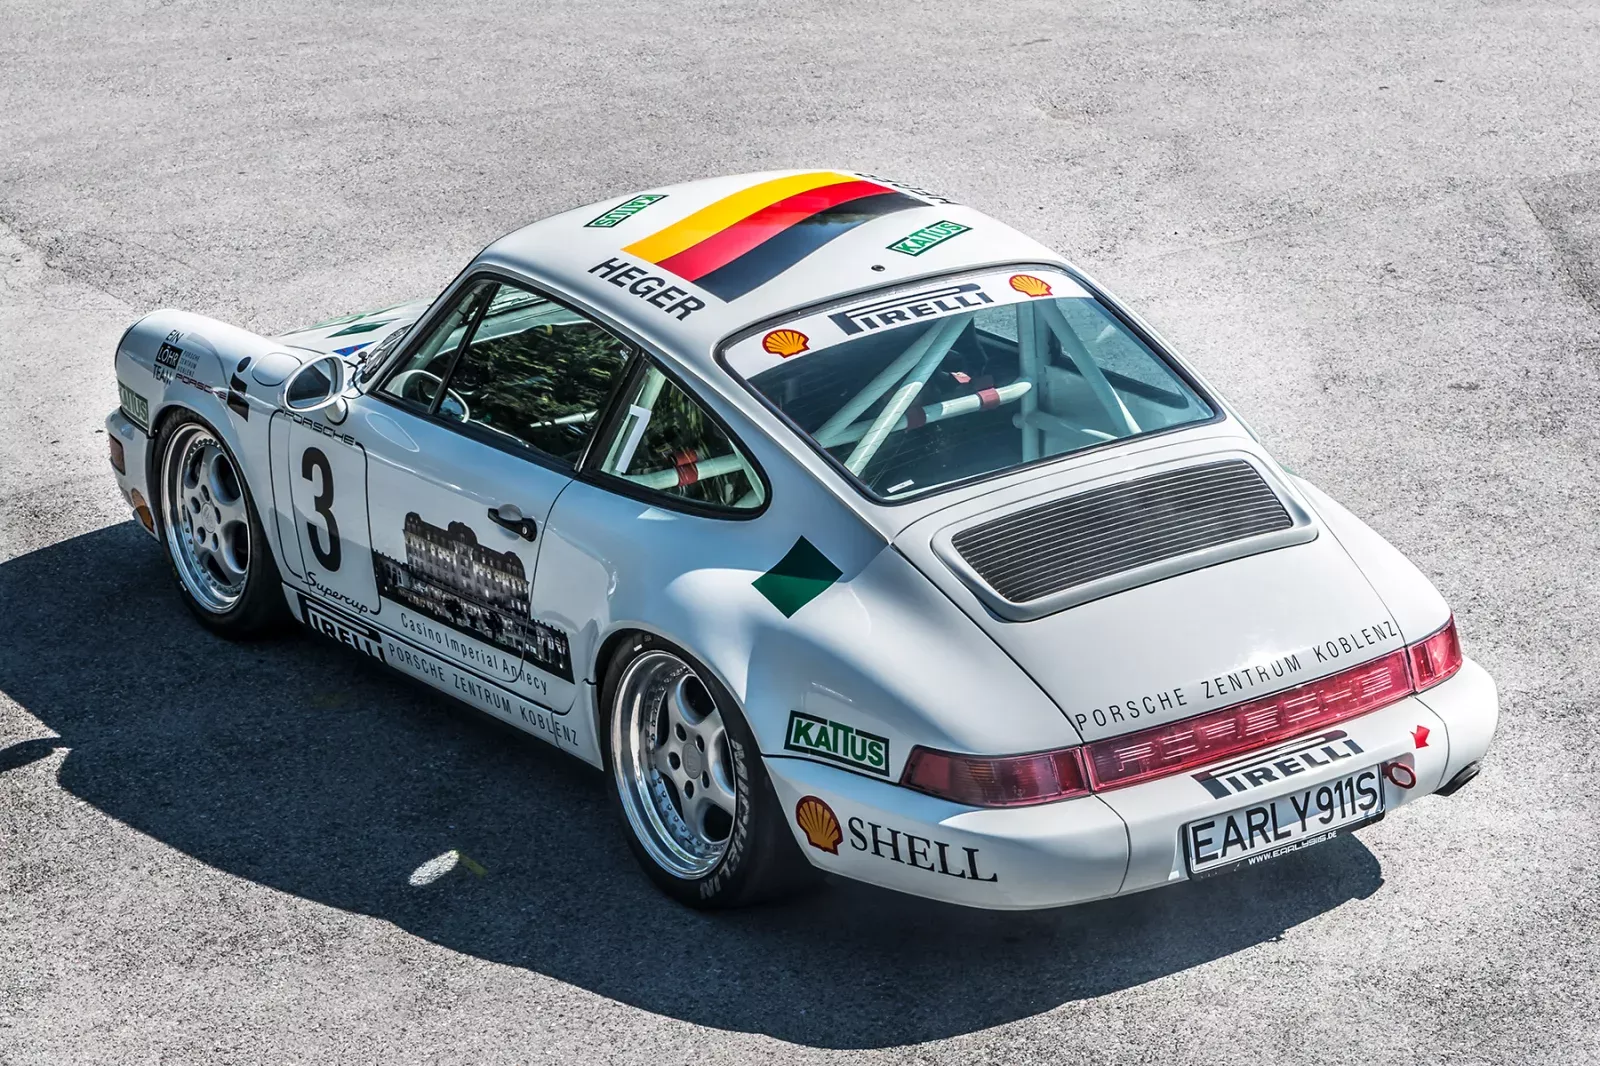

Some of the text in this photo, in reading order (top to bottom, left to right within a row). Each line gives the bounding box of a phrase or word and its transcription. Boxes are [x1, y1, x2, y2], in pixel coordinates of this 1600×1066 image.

[594, 195, 660, 226] KATTUS
[895, 223, 963, 253] KATTUS
[587, 257, 706, 321] HEGER
[827, 283, 994, 336] PIRELLI
[165, 329, 184, 344] EIN
[175, 373, 227, 400] PORSCHE
[284, 410, 355, 446] PORSCHE
[301, 447, 342, 572] 3
[302, 571, 368, 614] Supercup
[296, 592, 386, 663] PIRELLI
[401, 613, 547, 695] Casino Imperial Annecy
[388, 643, 579, 746] PORSCHE ZENTRUM KOBLENZ
[1075, 620, 1398, 731] PORSCHE ZENTRUM KOBLENZ
[792, 719, 884, 767] KATTUS
[1191, 729, 1365, 800] PIRELLI
[848, 816, 998, 883] SHELL
